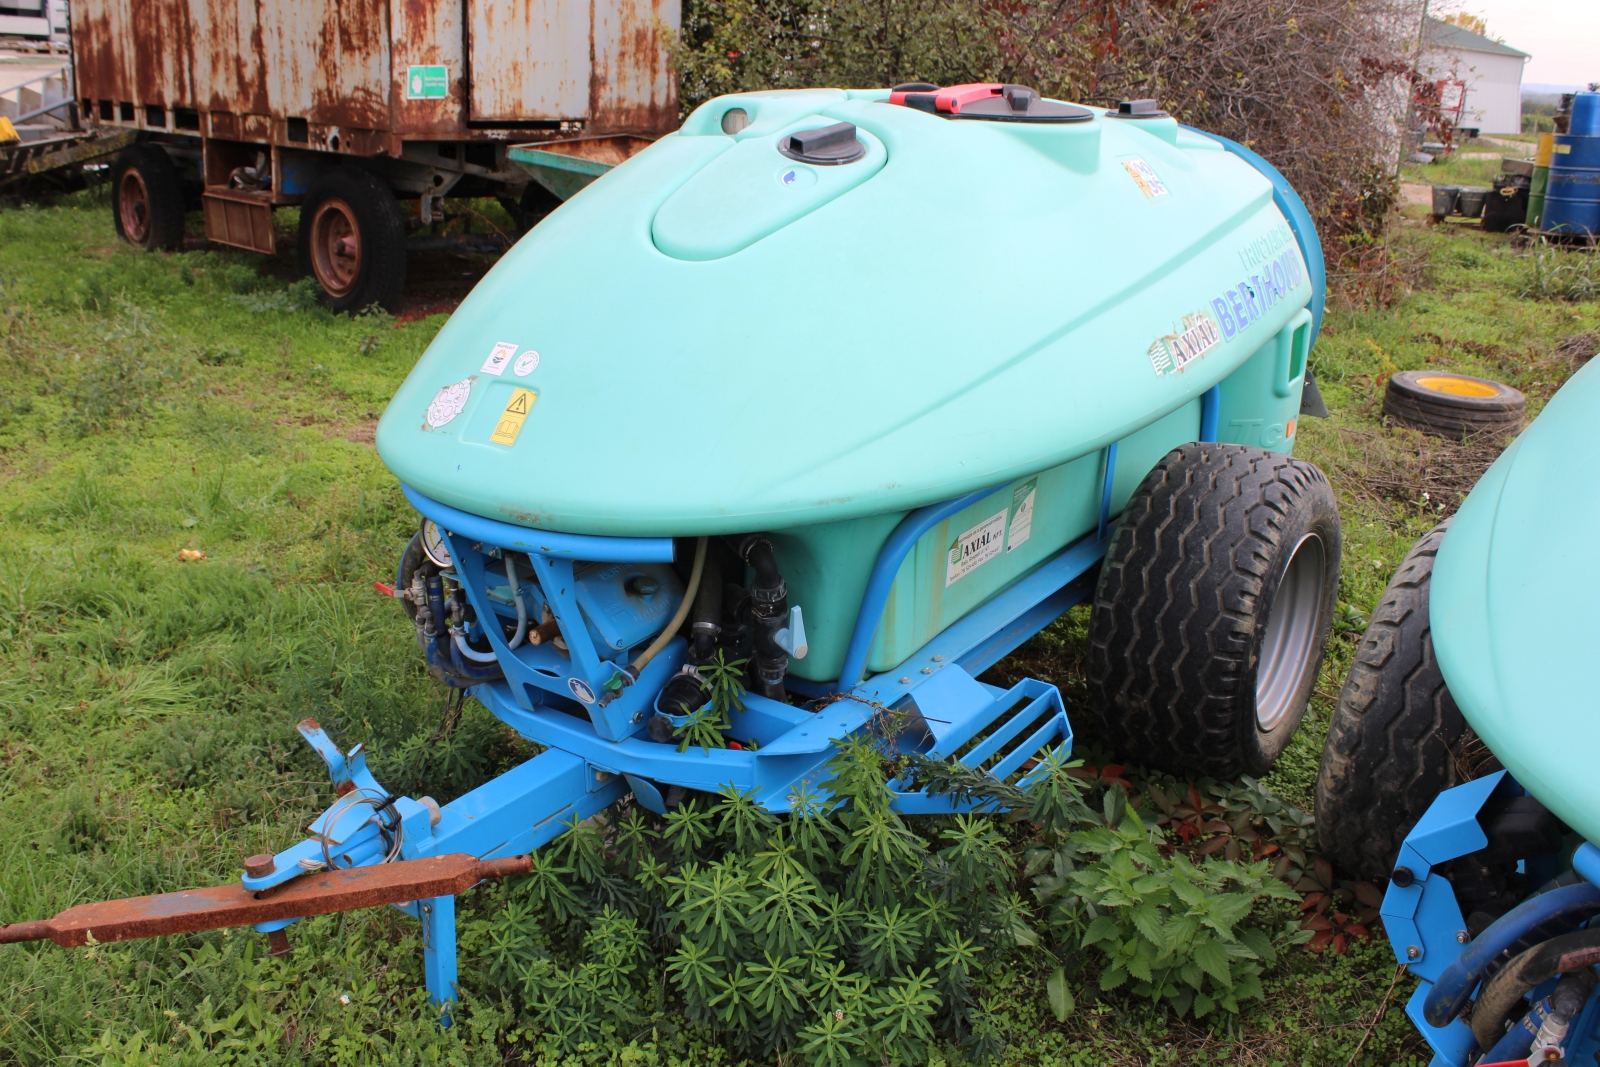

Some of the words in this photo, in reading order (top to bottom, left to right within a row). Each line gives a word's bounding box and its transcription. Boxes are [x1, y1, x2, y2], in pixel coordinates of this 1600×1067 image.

[1211, 247, 1302, 342] BERTHOUD
[1172, 315, 1219, 367] AXIÁL
[963, 529, 991, 559] AXIÁL
